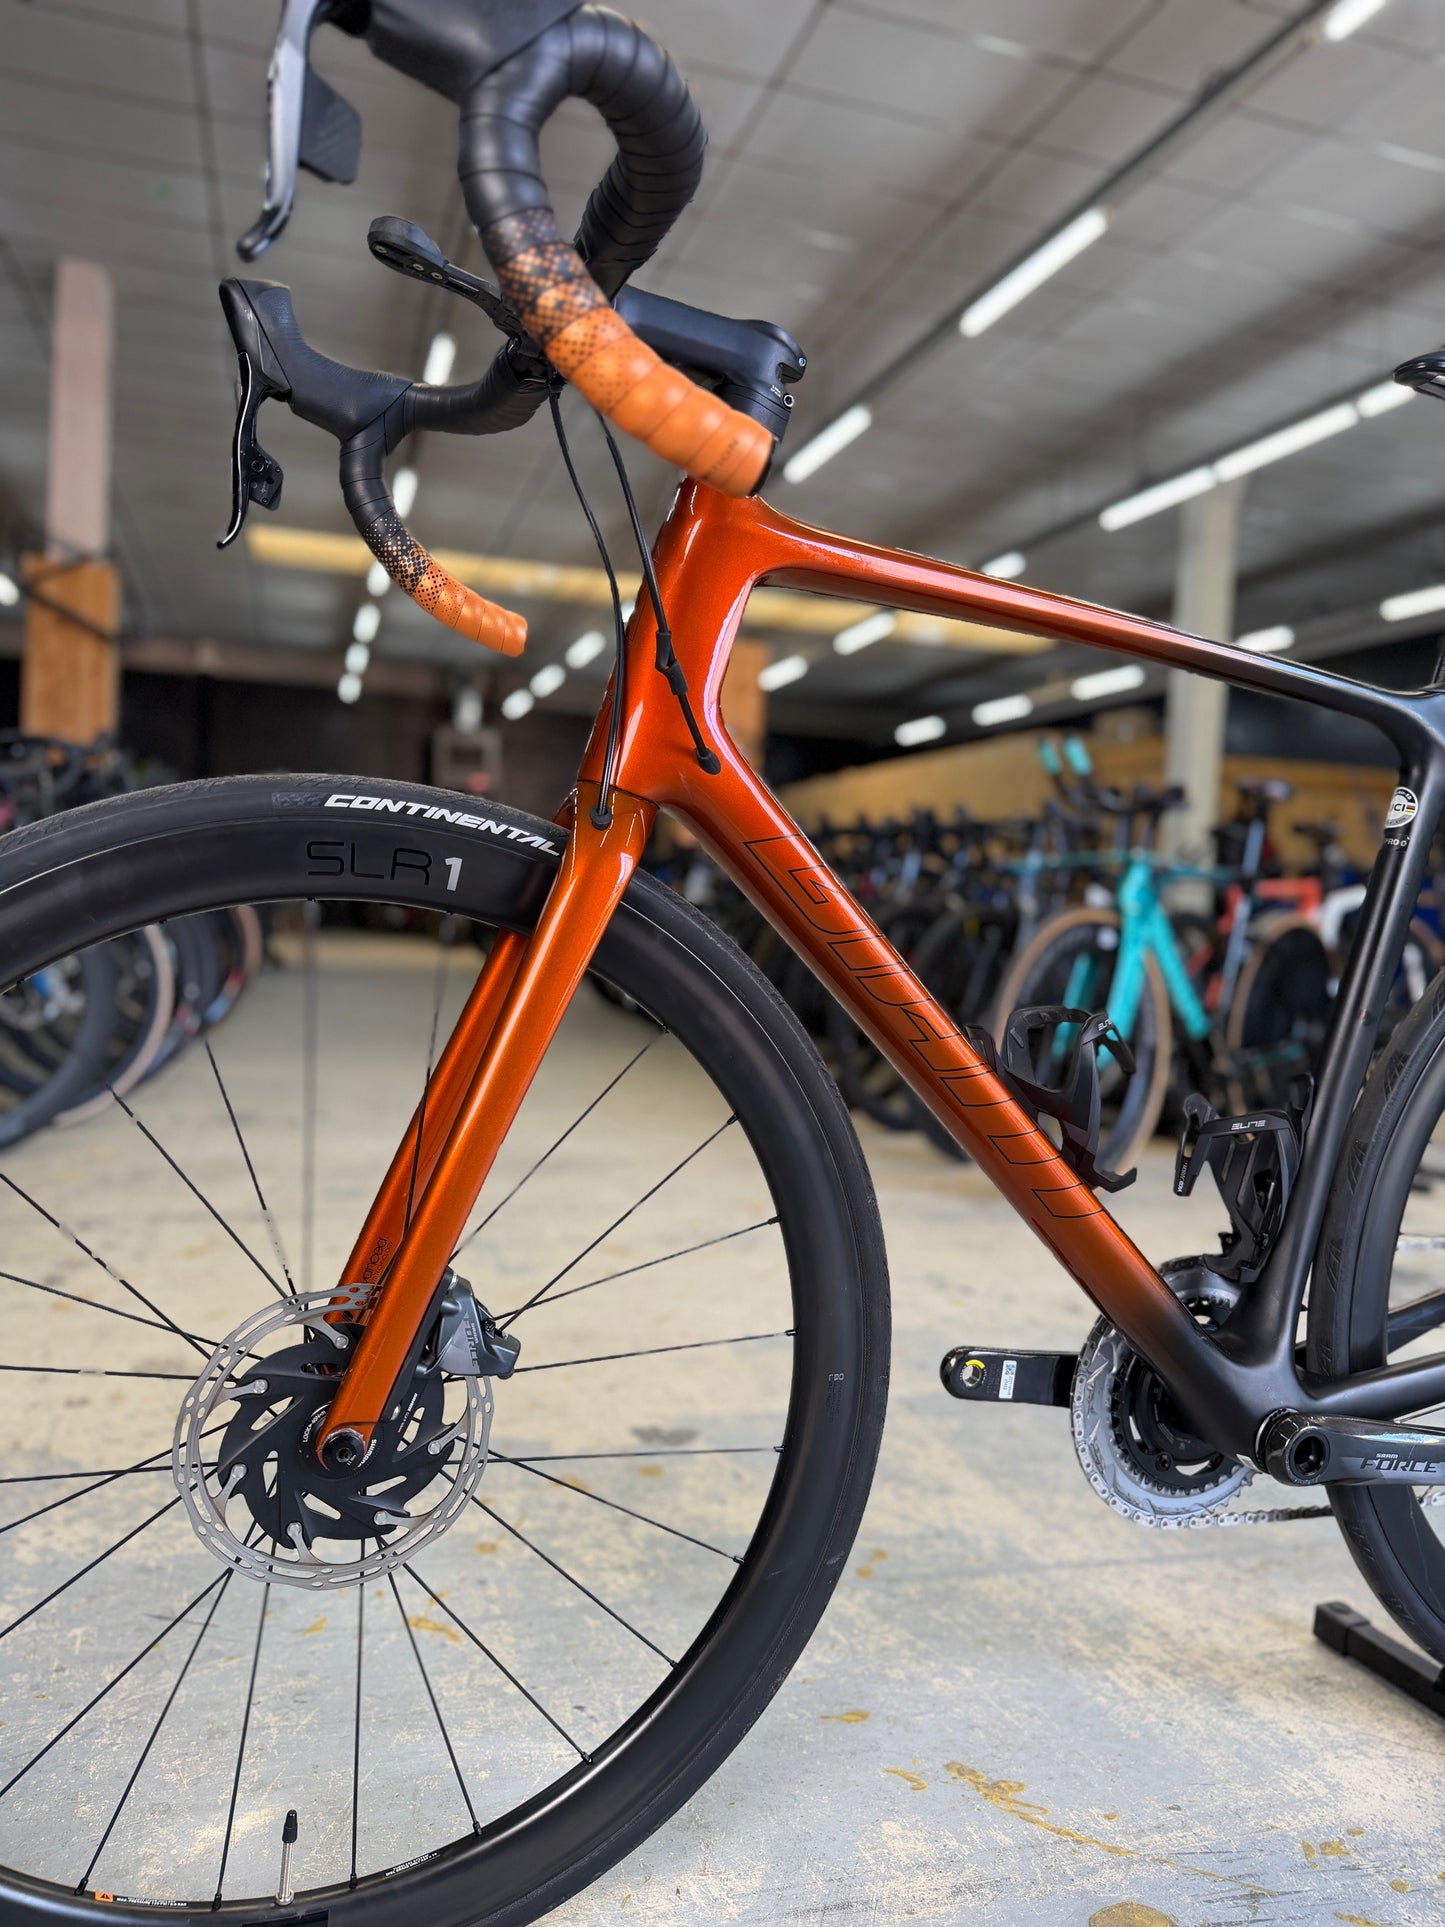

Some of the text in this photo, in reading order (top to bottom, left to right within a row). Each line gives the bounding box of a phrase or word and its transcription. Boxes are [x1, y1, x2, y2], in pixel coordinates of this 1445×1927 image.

[324, 793, 560, 857] CONTINENTAL
[307, 840, 464, 892] SLR 1
[463, 1317, 478, 1368] FORCE
[1360, 1458, 1441, 1473] FORCE
